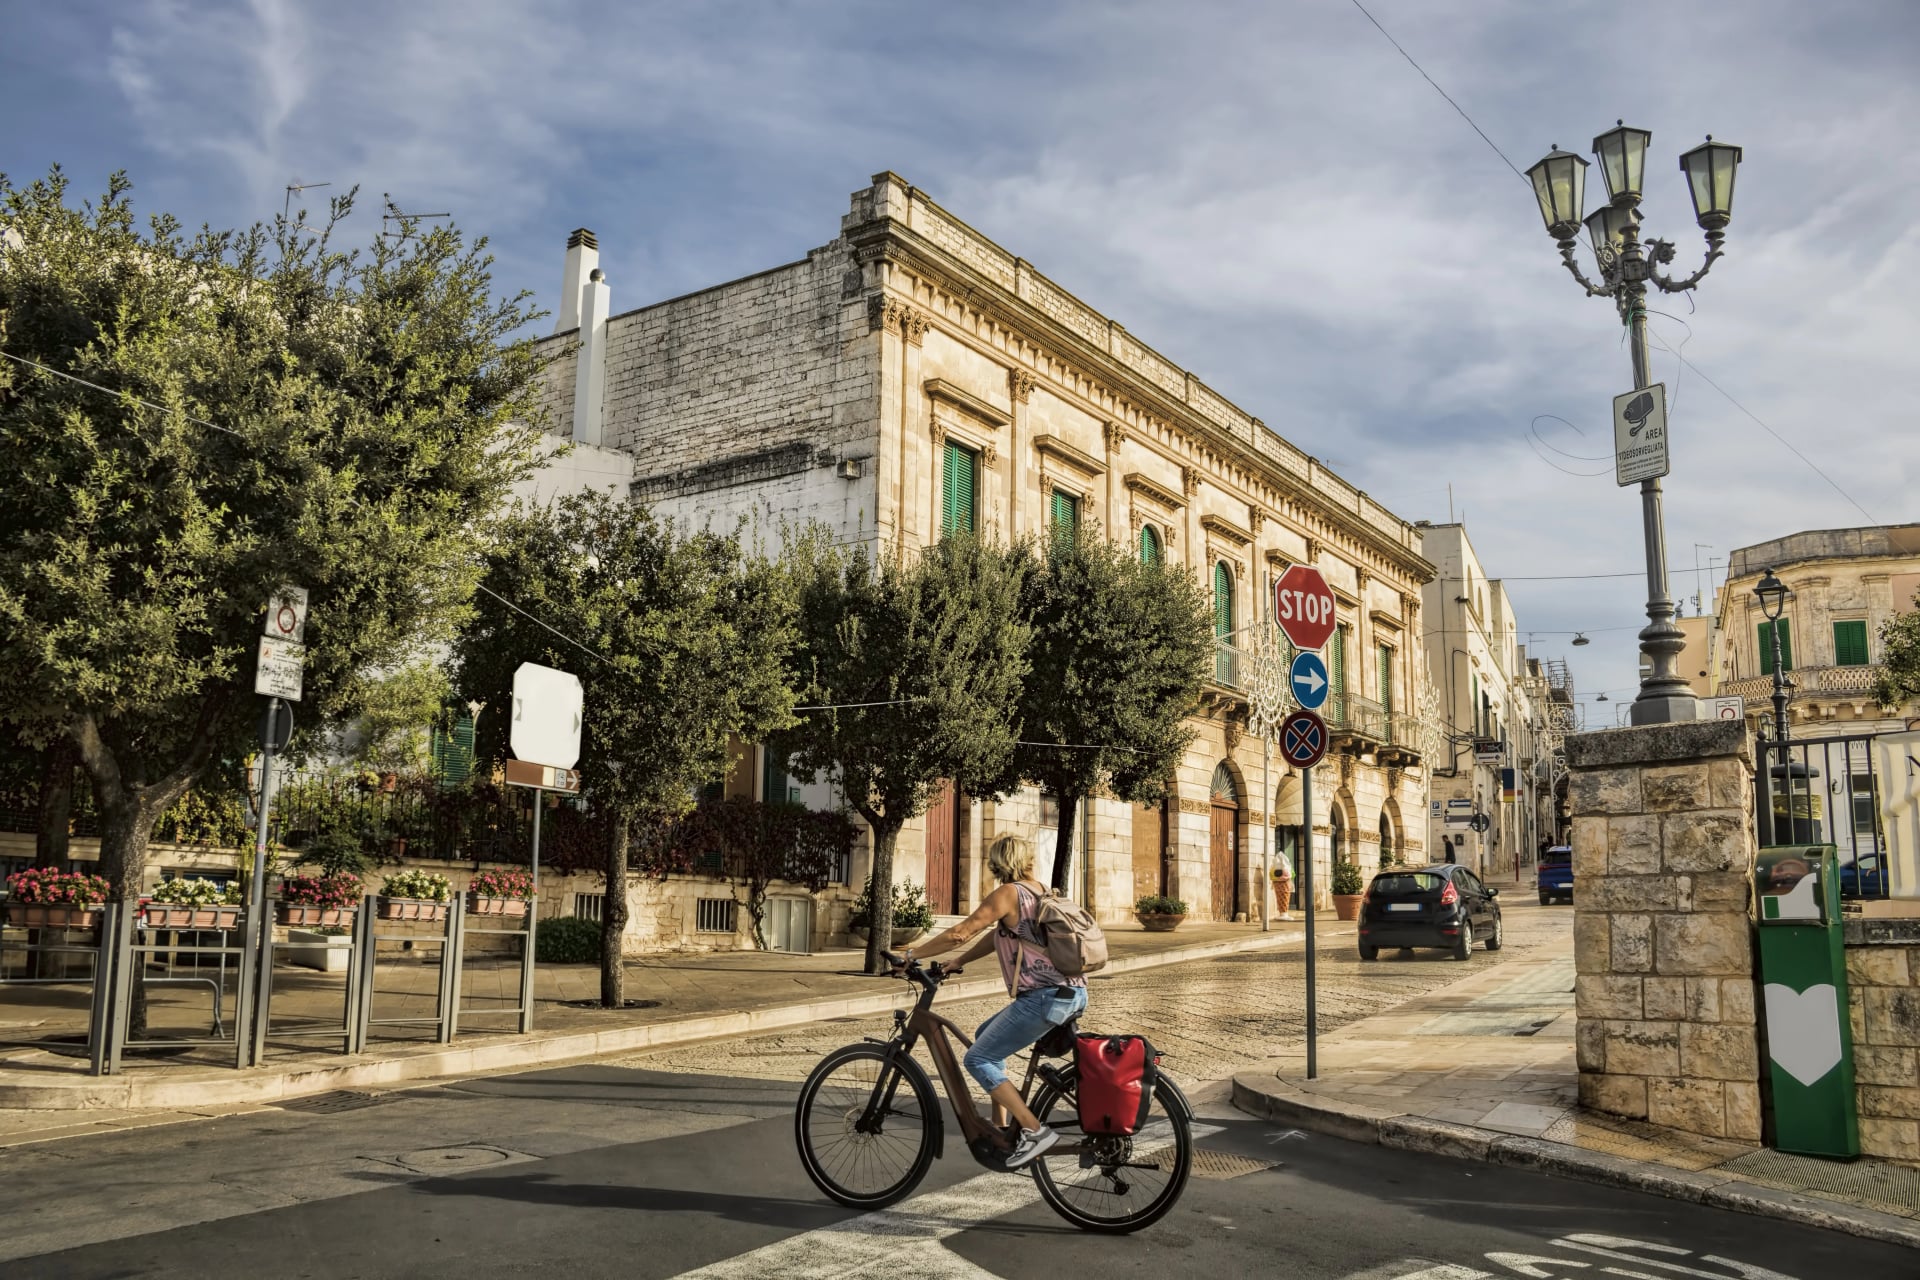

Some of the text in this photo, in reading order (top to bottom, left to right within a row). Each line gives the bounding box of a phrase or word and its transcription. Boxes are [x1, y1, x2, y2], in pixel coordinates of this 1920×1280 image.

[1645, 427, 1663, 441] AREA
[1618, 442, 1664, 461] VIDEOSORVEGLIATA
[1281, 590, 1332, 625] STOP
